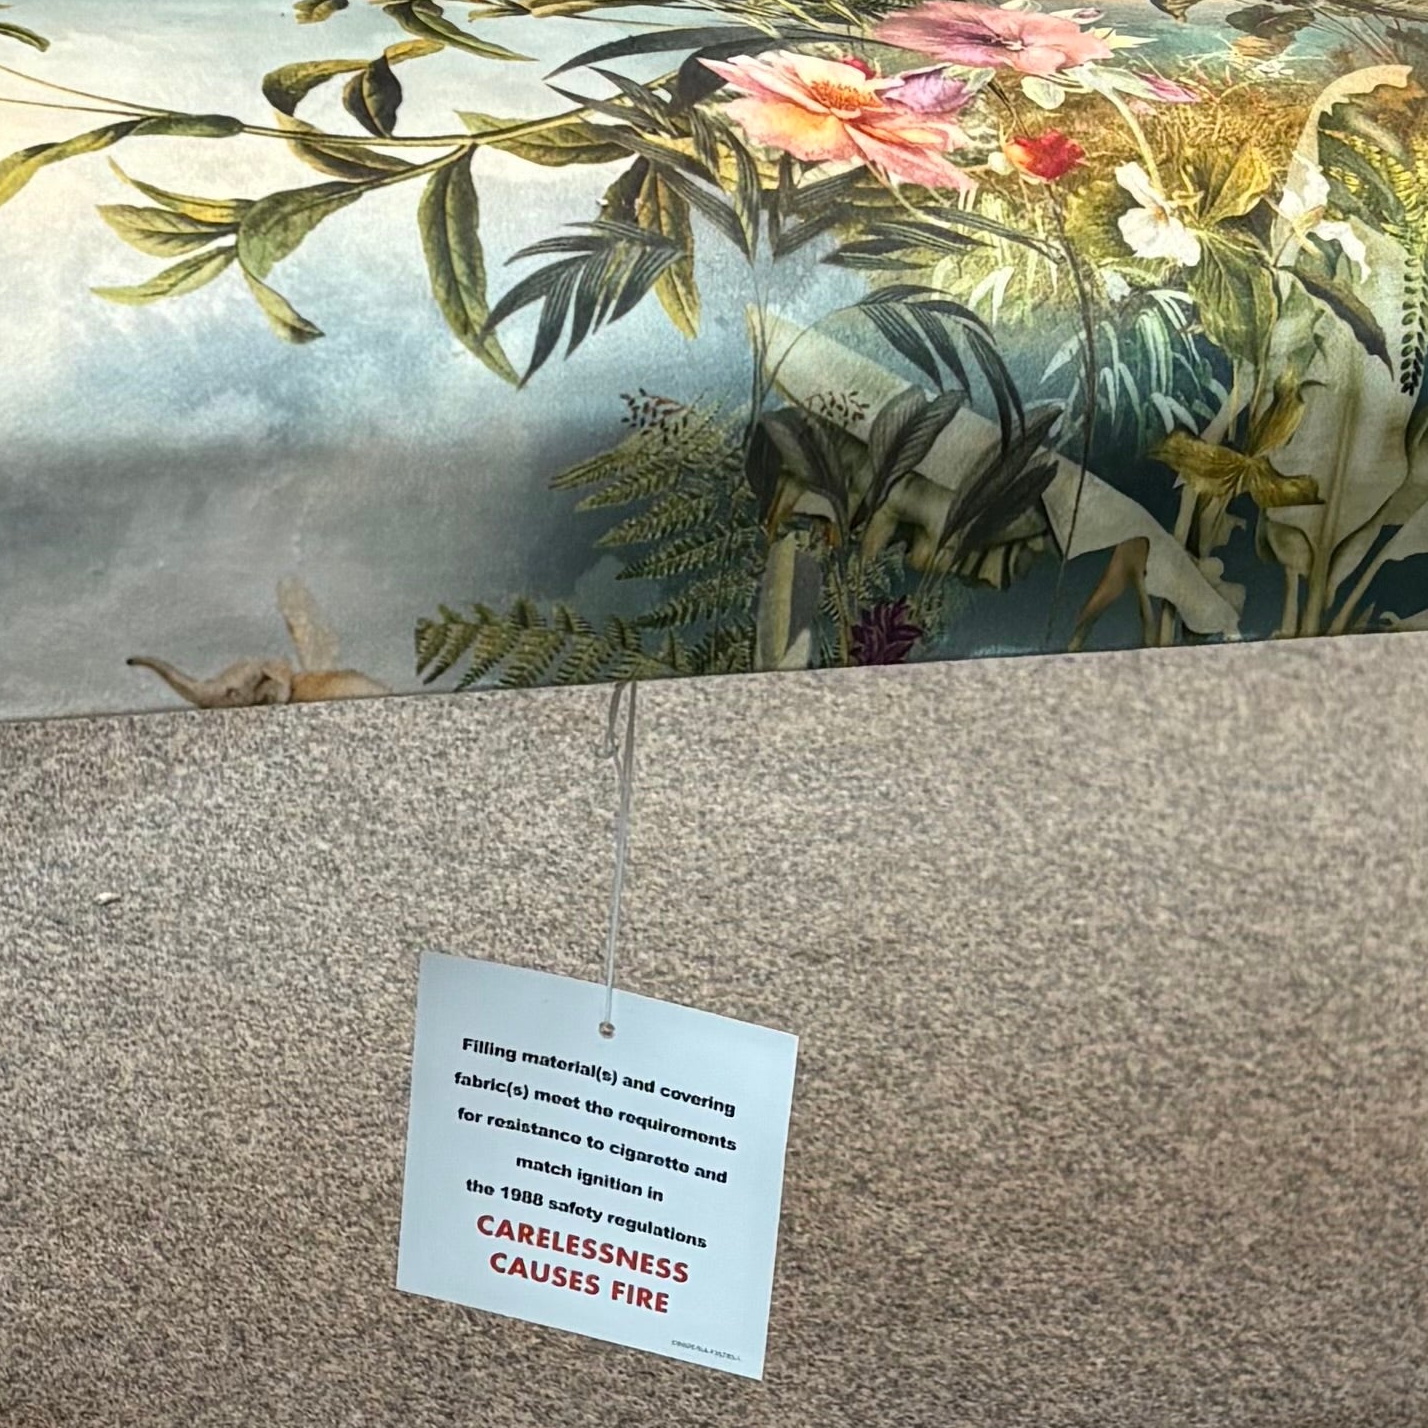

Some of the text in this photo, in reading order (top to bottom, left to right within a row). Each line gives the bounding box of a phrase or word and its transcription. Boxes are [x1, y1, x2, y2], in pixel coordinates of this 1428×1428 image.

[454, 1071, 737, 1151] fabric(s) meet the requirements
[462, 1037, 736, 1118] Filling material(s) and covering
[457, 1106, 728, 1184] for resistance to cigarette and
[515, 1156, 664, 1203] match ignition in
[465, 1178, 708, 1249] the 1988 safety regulations
[476, 1214, 689, 1284] CARELESSNESS
[489, 1251, 670, 1314] CAUSES FIRE
